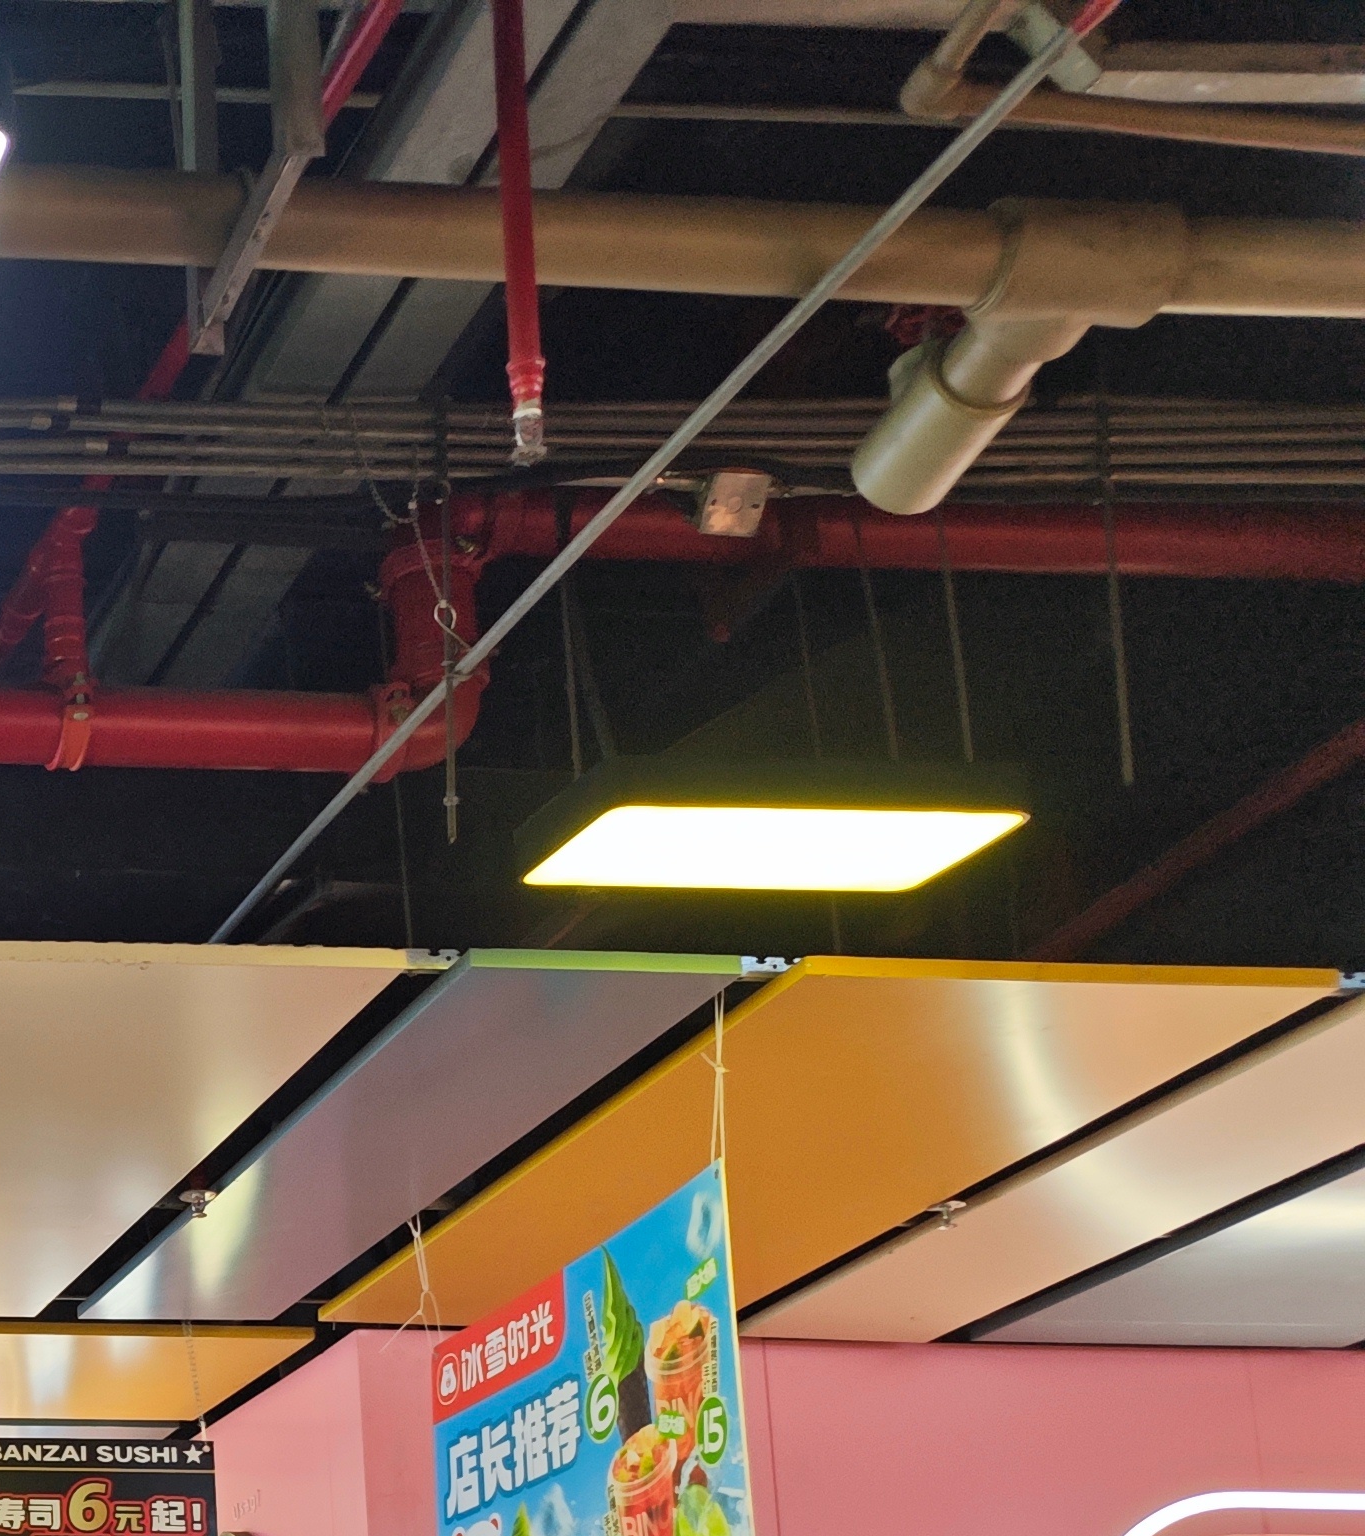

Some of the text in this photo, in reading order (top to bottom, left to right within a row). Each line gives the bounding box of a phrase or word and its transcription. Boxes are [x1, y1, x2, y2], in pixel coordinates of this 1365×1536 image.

[461, 1300, 555, 1393] 冰雪时光
[96, 1445, 178, 1464] SUSHI
[447, 1379, 581, 1519] 店长推荐
